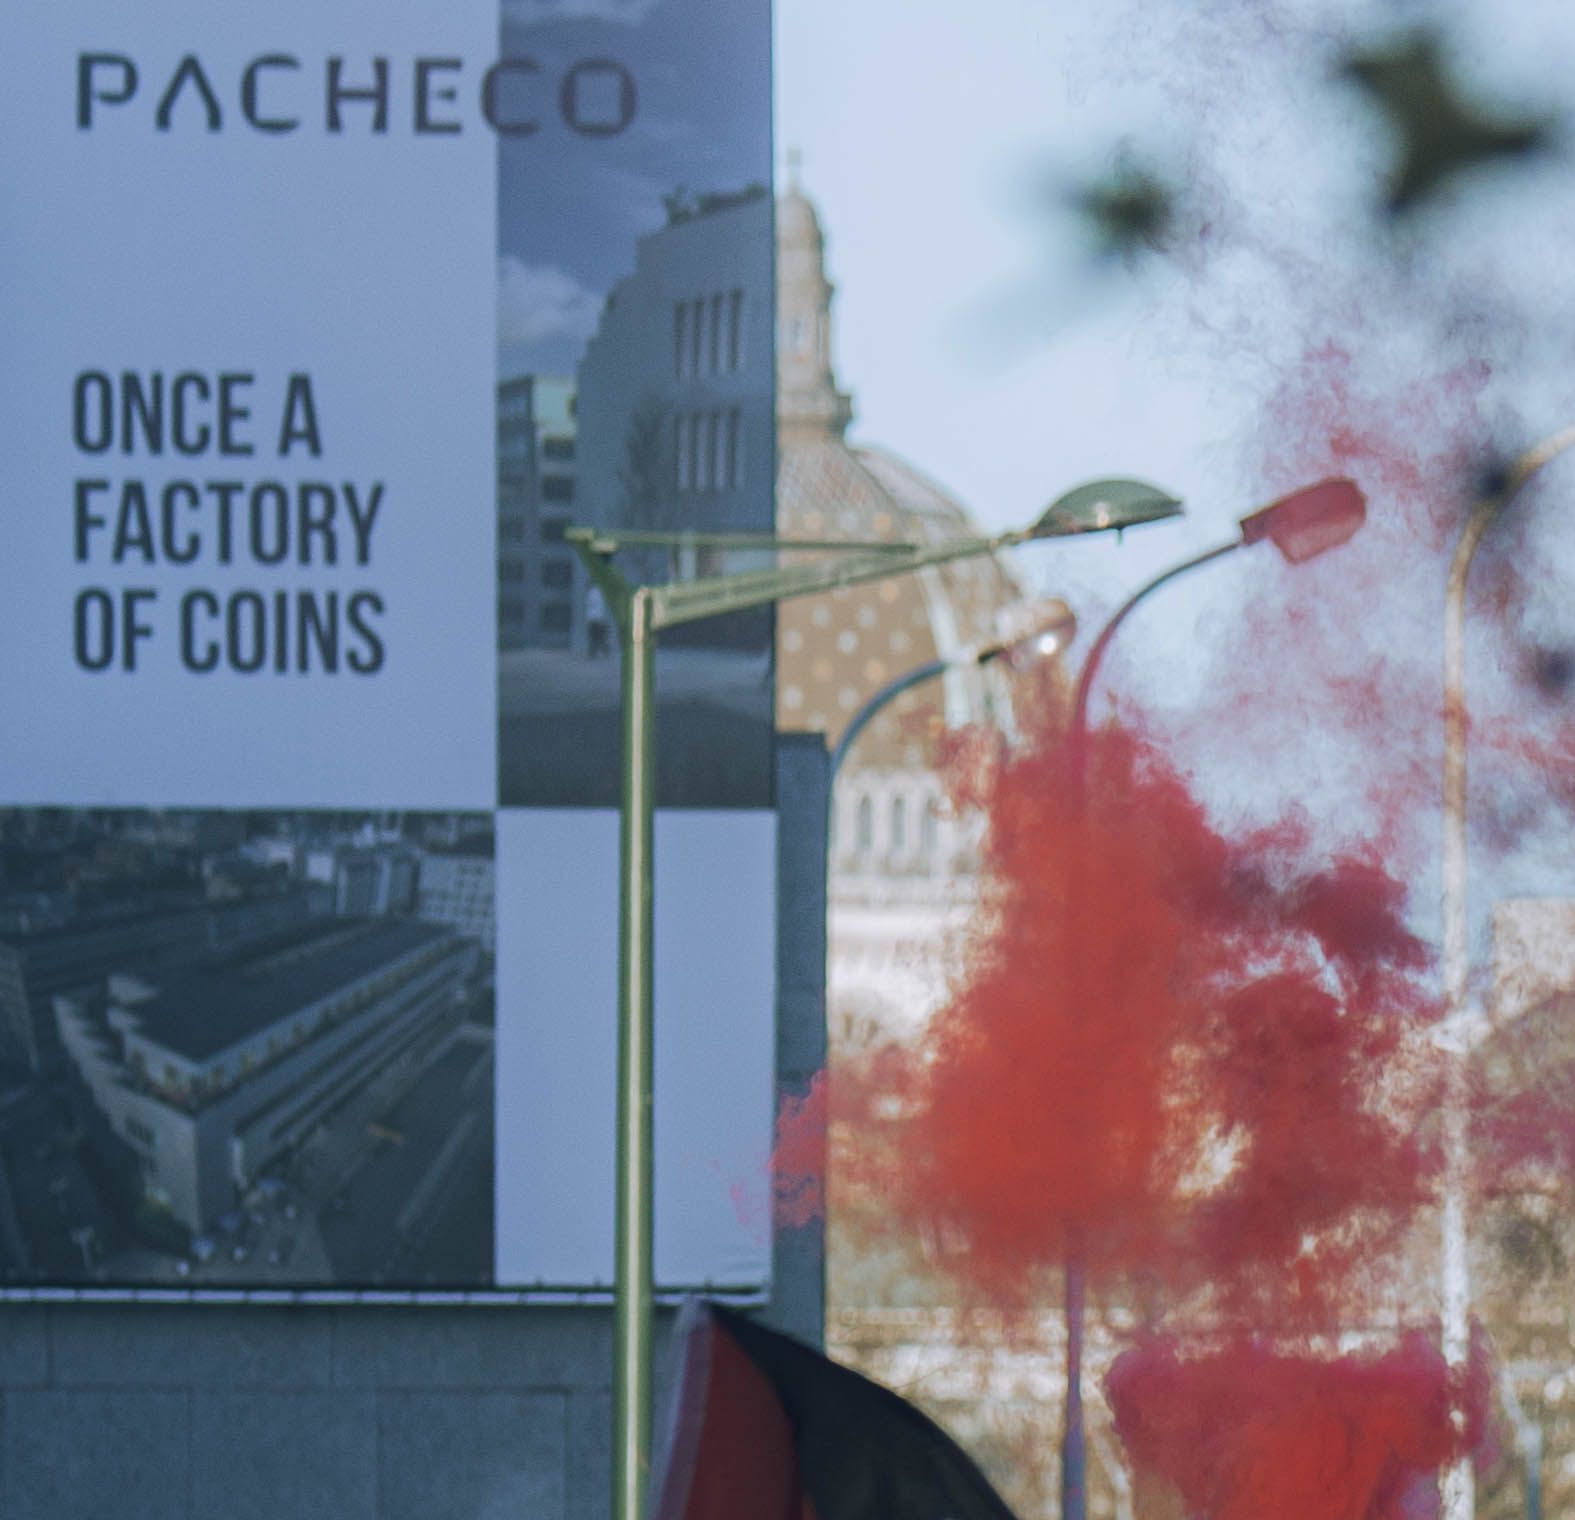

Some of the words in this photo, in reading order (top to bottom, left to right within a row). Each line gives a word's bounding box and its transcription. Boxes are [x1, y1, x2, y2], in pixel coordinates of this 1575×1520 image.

[76, 52, 638, 137] PACHECO
[73, 370, 255, 457] ONCE
[278, 372, 322, 458] A
[73, 479, 385, 567] FACTORY
[73, 587, 157, 674] OF
[180, 589, 386, 677] COINS
